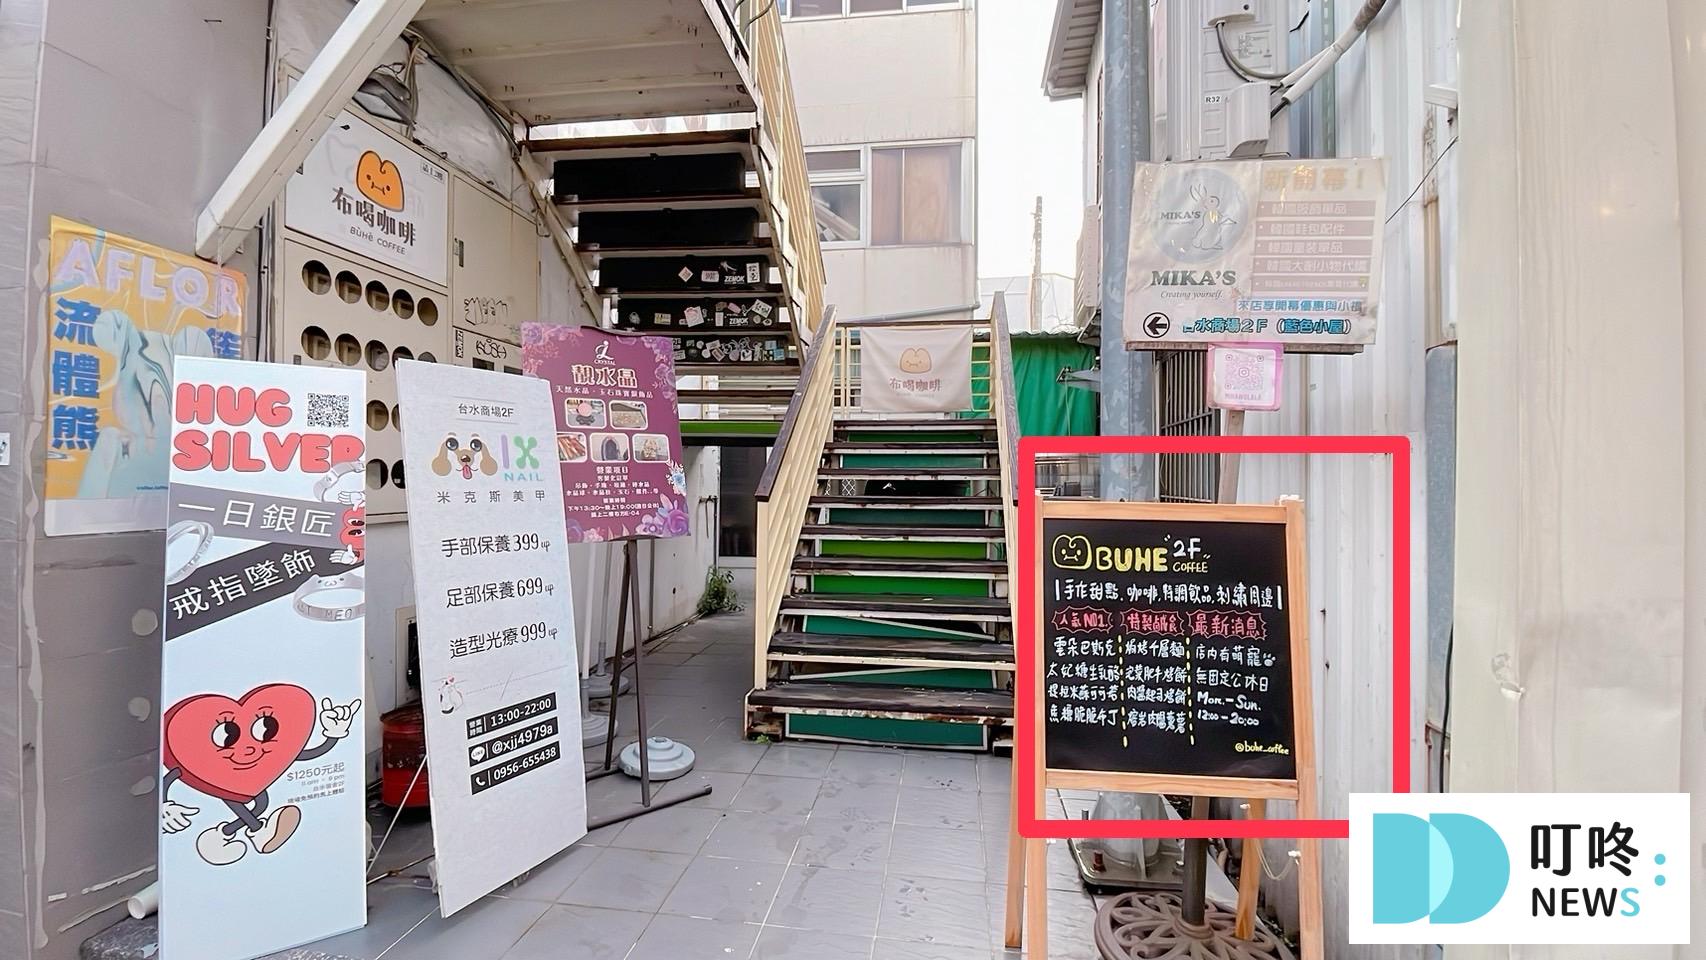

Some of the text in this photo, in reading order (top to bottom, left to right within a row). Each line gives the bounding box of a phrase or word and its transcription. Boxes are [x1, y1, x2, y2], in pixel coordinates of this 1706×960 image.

[332, 187, 416, 246] 布喝咖啡
[1160, 211, 1200, 220] MIKA'S
[377, 238, 406, 255] COFFEE
[1150, 270, 1236, 286] MIKA'S
[1160, 290, 1191, 299] Creating
[53, 297, 102, 450] 流體熊
[571, 364, 638, 388] 靚水晶
[176, 383, 292, 427] HUG
[458, 403, 514, 418] 台水商場2F
[504, 472, 544, 481] NAIL
[437, 490, 546, 503] 米克斯美甲
[178, 498, 337, 537] 一日銀匠
[1096, 546, 1169, 573] BUHE
[1172, 561, 1208, 573] COFFEE
[169, 549, 316, 619] 戒指墜飾
[1195, 613, 1260, 637] 最新消息
[1054, 636, 1116, 657] 雲朵巴斯克
[1196, 644, 1262, 667] 店內有萌寵
[1046, 661, 1120, 681] 太妃糖生乳酪
[1196, 667, 1269, 692] 無固定公休日
[490, 698, 551, 727] 13:00-22:00
[492, 725, 553, 754] @xjj4979a
[287, 762, 345, 781] $1250元起
[493, 747, 556, 780] 0956-655438
